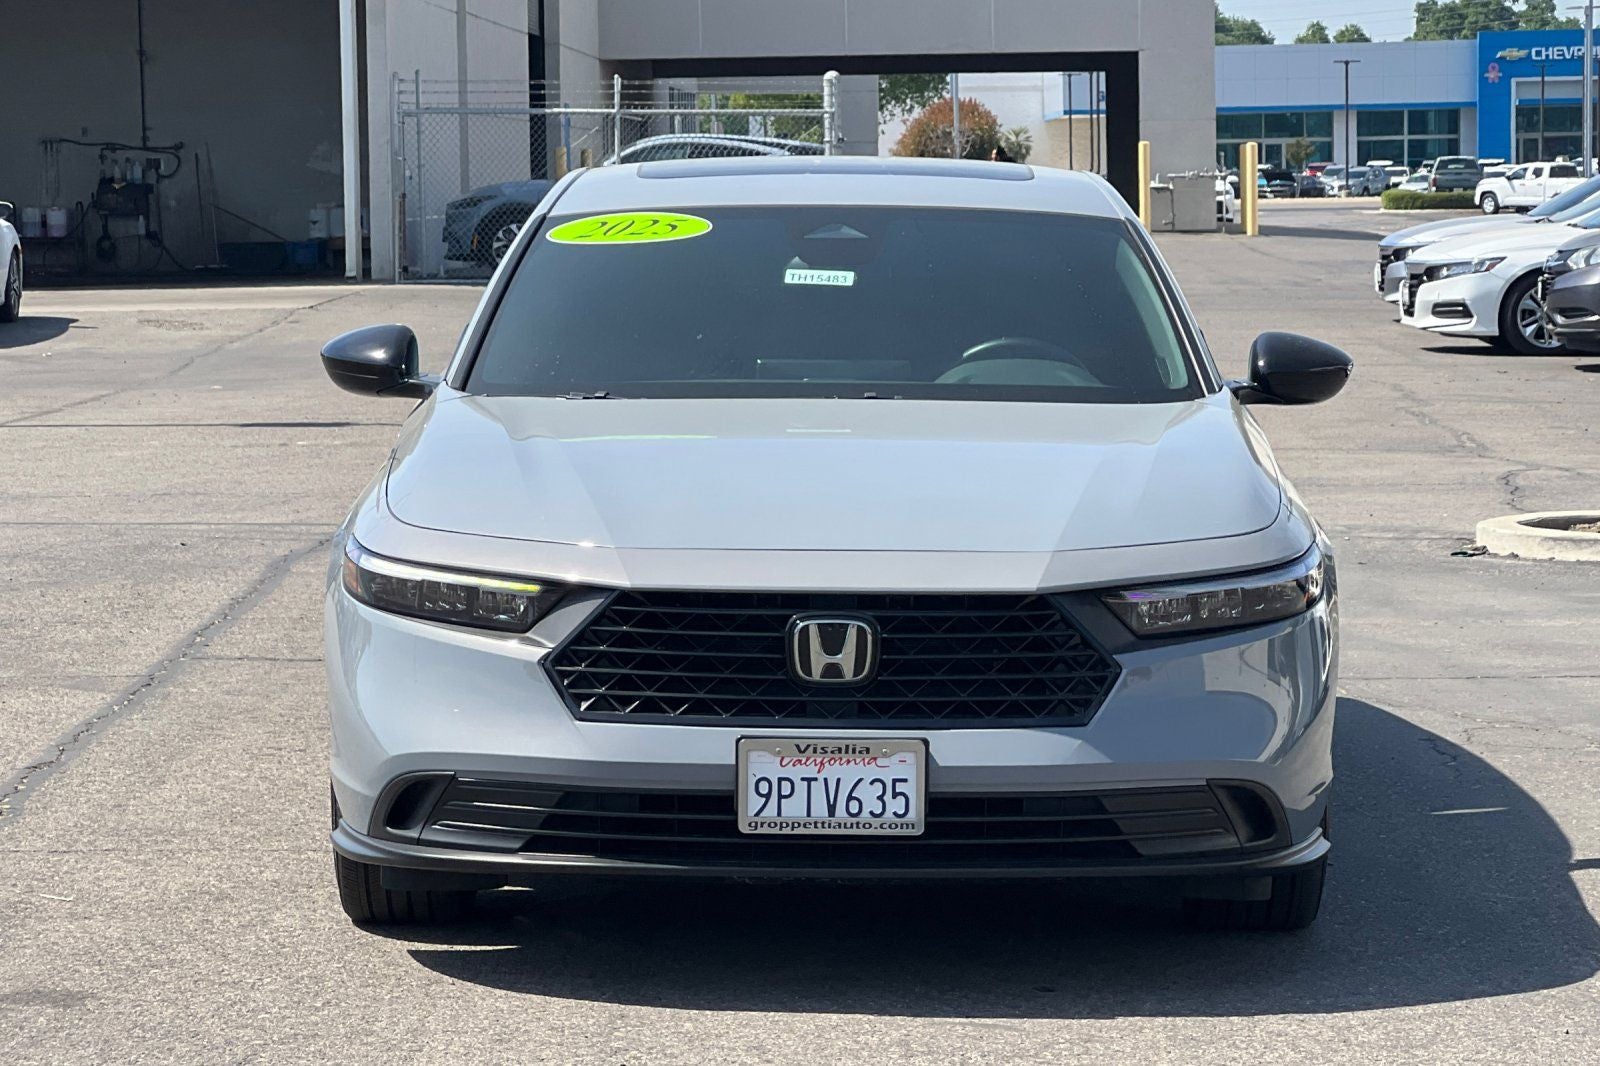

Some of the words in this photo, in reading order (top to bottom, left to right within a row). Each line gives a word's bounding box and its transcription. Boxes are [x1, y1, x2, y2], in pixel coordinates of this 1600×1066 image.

[1532, 45, 1600, 60] CHEVR
[575, 219, 687, 238] 2025
[789, 272, 847, 284] TH15483
[794, 744, 870, 754] Visalia
[779, 756, 890, 774] California
[754, 776, 910, 818] 9PTV635
[748, 820, 916, 832] groppettiauto.com
